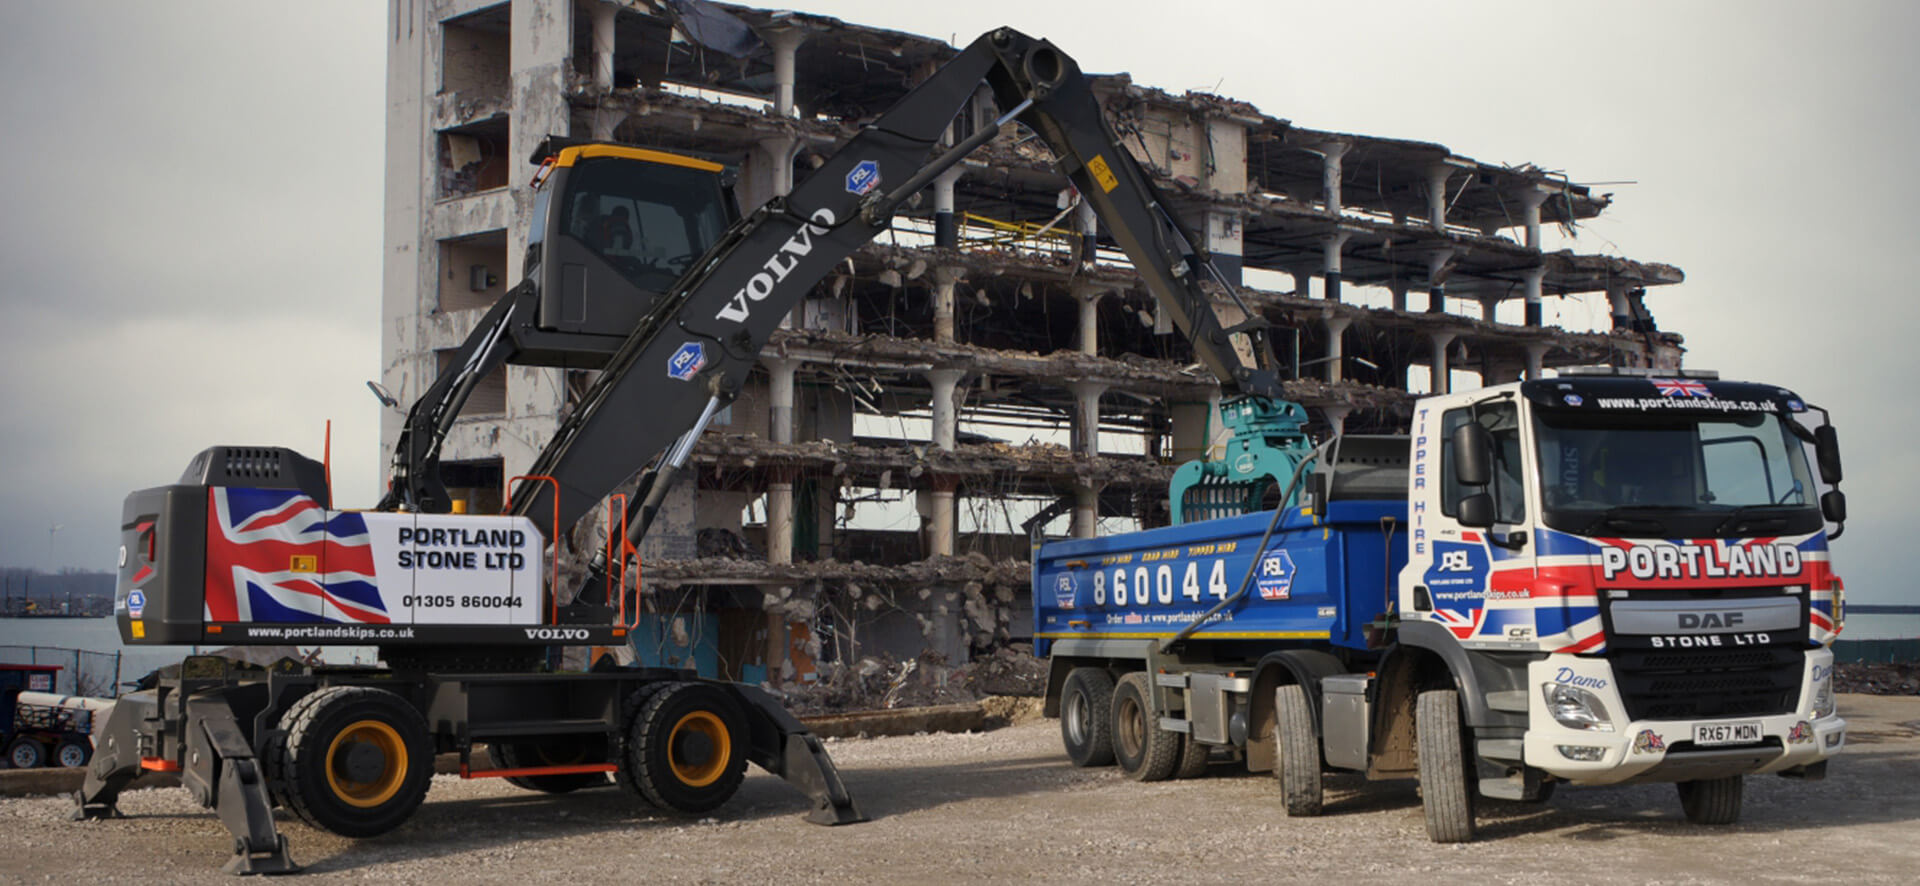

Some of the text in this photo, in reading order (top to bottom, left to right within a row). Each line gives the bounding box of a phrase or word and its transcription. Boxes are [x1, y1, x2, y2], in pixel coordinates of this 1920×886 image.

[851, 168, 871, 185] PSL
[715, 208, 836, 323] VOLVO
[674, 350, 695, 369] PSL
[1597, 397, 1779, 412] www.portlandskips.co.uk
[1414, 409, 1428, 555] TIPPER HIRE
[1563, 447, 1579, 499] SPUR
[398, 528, 526, 549] PORTLAND
[398, 551, 525, 571] STONE LTD
[1263, 557, 1285, 577] PSL
[1438, 550, 1473, 571] PSL
[1601, 544, 1801, 579] PORTLAND
[1094, 559, 1228, 607] 860044
[402, 595, 522, 608] 01305 860044
[1435, 588, 1530, 602] www.portlandskips.co.uk
[1152, 609, 1233, 624] www.portlandsks.co.uk
[1678, 612, 1744, 630] DAF
[248, 625, 414, 640] www.portlandskips.co.uk
[524, 629, 590, 640] VOLVO
[1509, 628, 1531, 638] CF
[1651, 633, 1770, 648] STONE LTD
[1555, 667, 1607, 688] Damo
[1700, 724, 1758, 741] RX67 MDN
